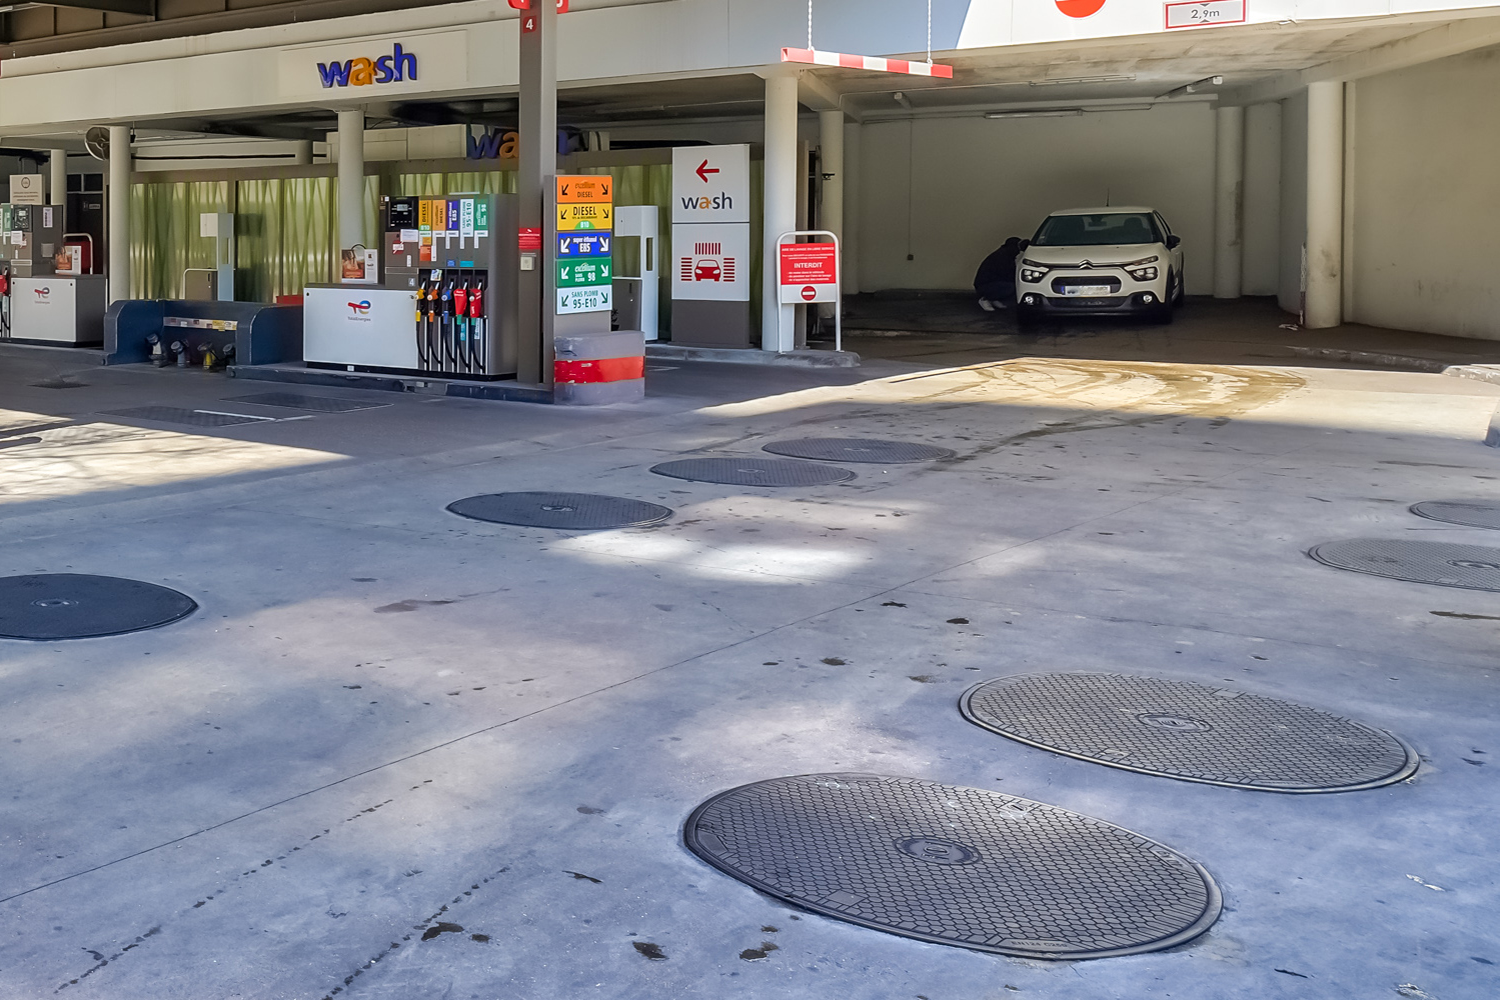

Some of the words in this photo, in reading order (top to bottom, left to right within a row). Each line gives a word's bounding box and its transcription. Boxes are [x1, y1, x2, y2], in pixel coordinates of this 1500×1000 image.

[1191, 9, 1220, 20] 2,9m
[526, 18, 533, 30] 4
[317, 43, 418, 89] wash
[681, 191, 732, 210] wash
[573, 206, 597, 216] DIESEL
[587, 272, 596, 281] 98
[408, 278, 416, 287] 4
[572, 298, 598, 309] 95-E10
